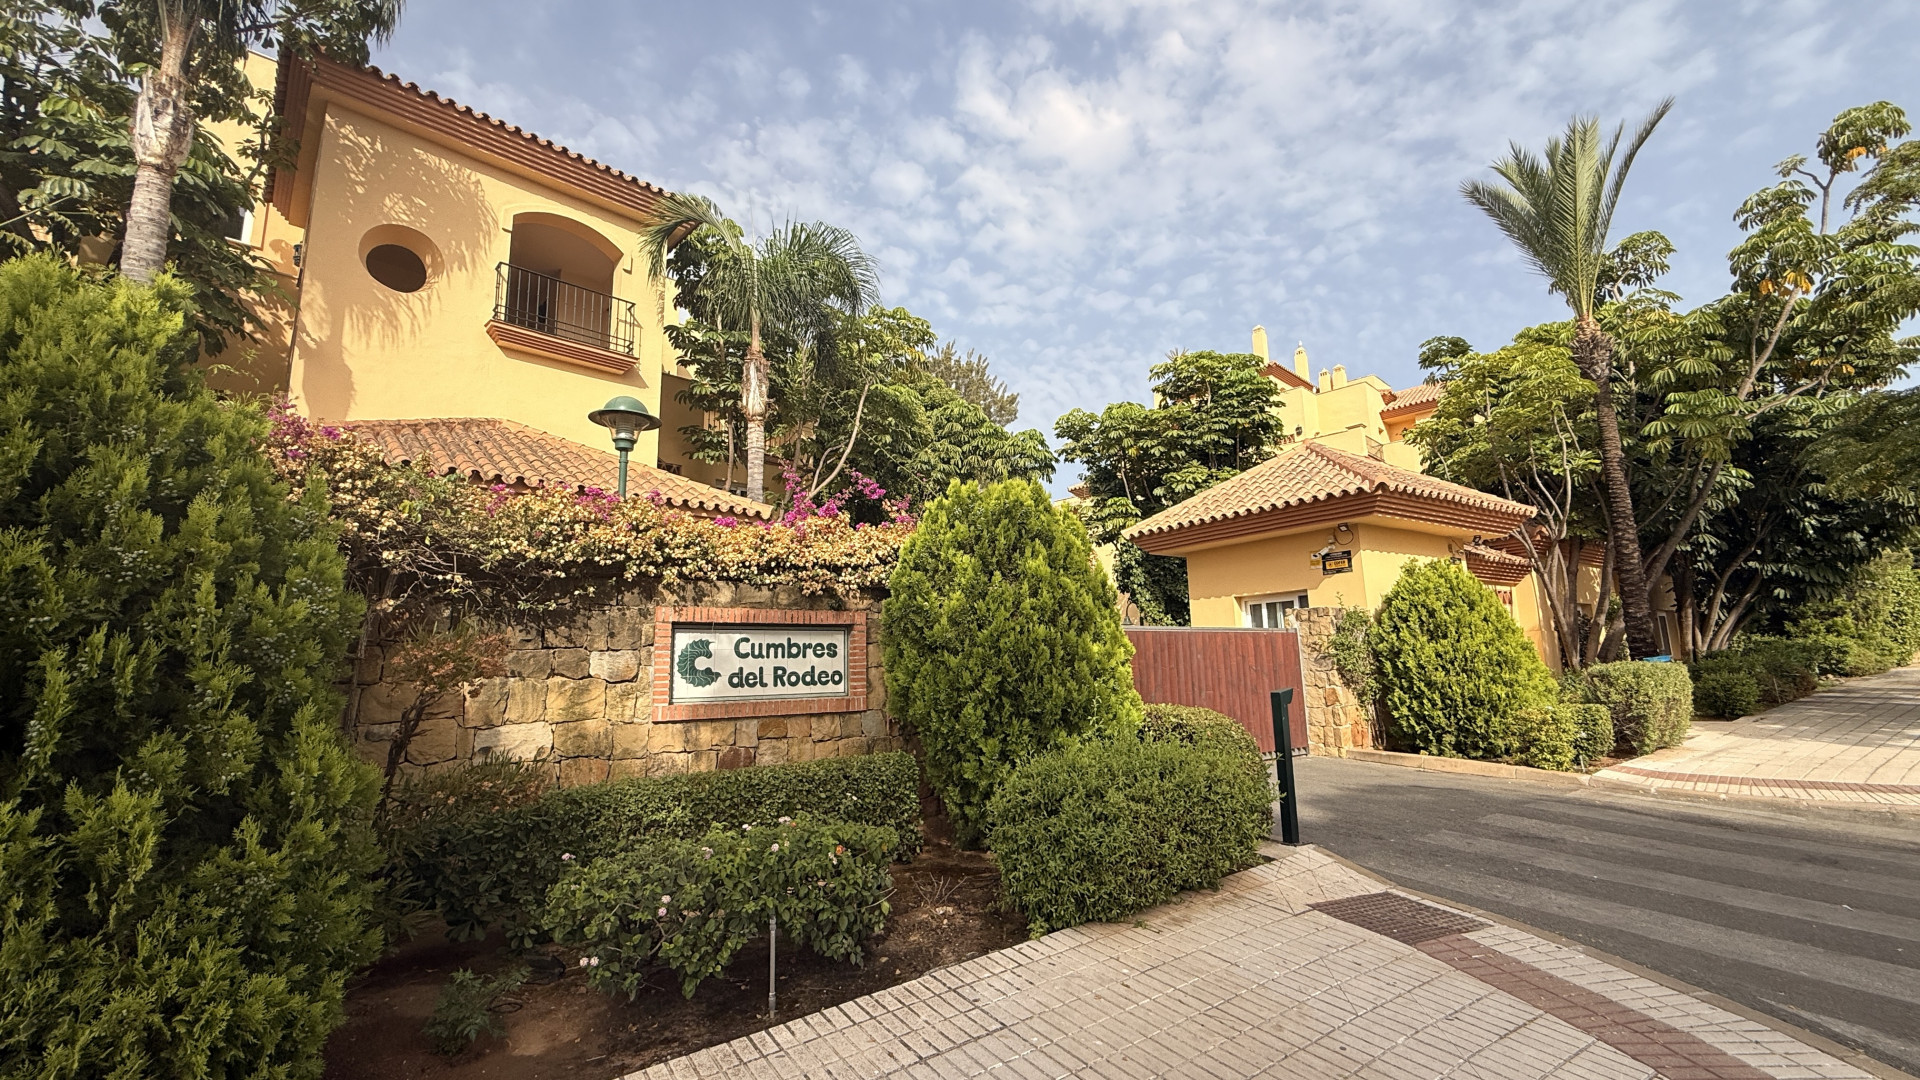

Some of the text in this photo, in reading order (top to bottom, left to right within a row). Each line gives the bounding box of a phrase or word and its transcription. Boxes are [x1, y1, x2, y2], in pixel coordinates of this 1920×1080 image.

[734, 637, 838, 659] Cumbres
[728, 665, 843, 688] del Rodeo
